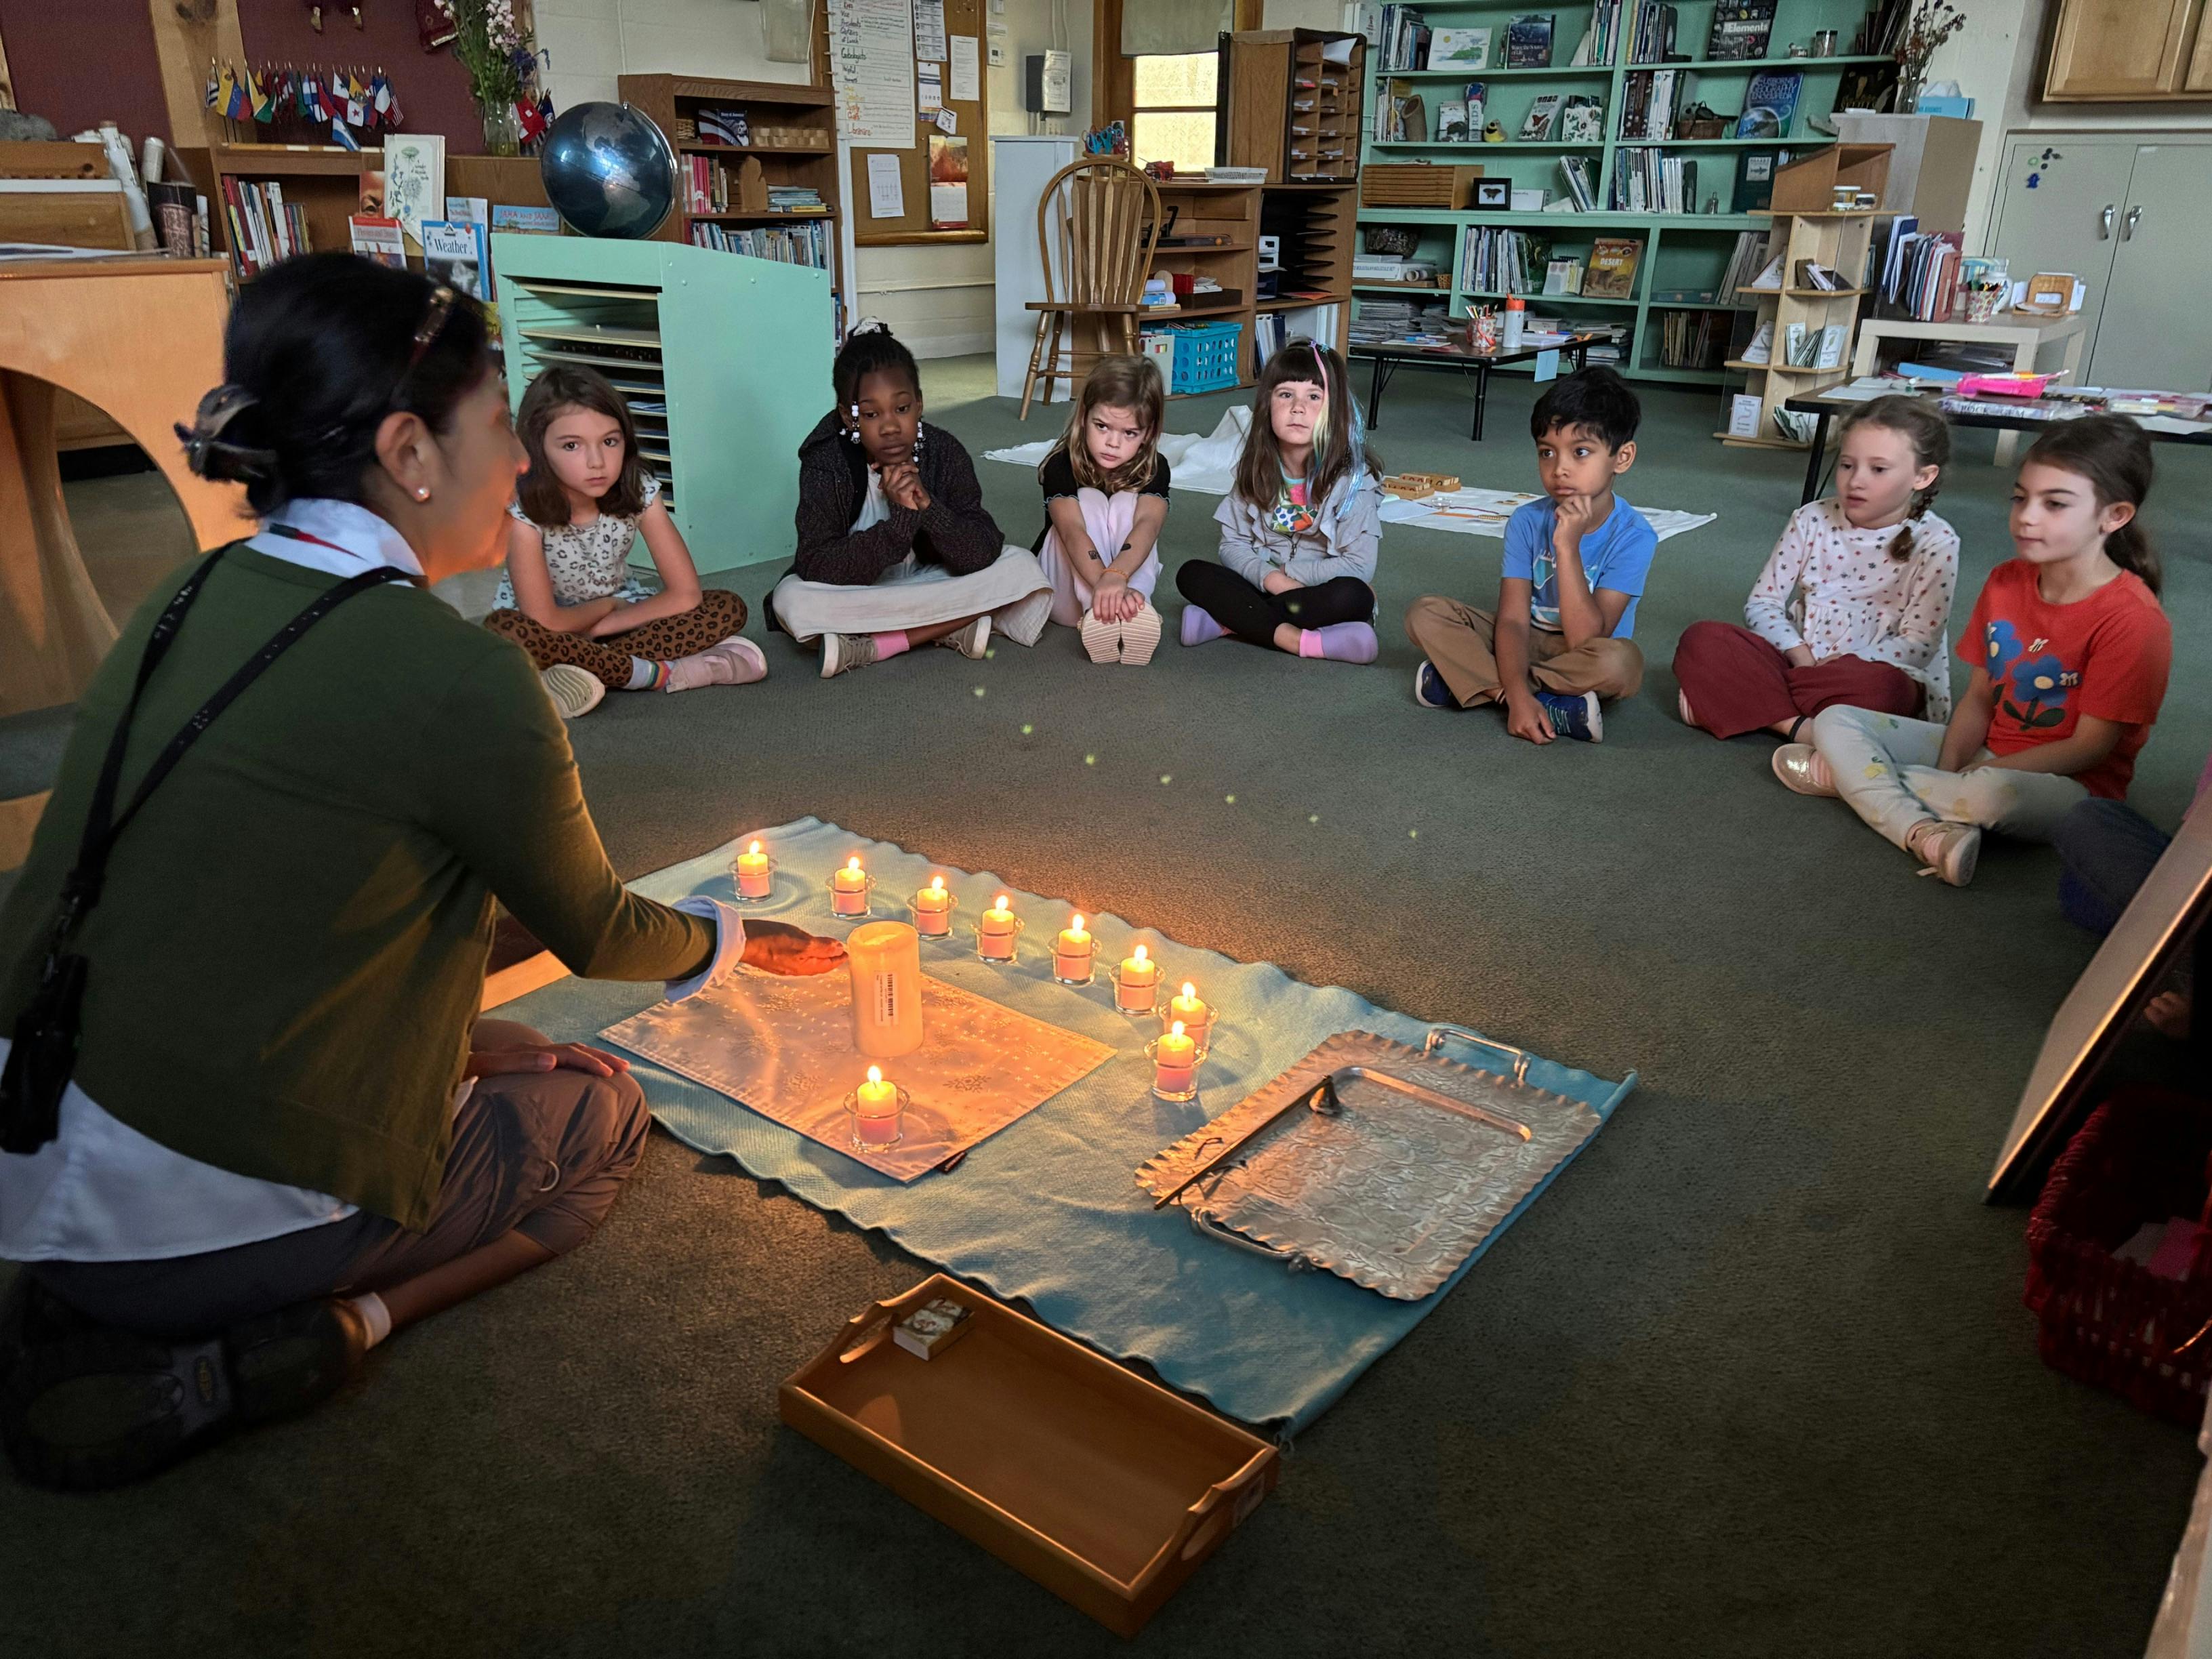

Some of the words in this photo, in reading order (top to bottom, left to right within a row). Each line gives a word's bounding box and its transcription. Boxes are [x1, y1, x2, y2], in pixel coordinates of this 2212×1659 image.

[1727, 21, 1768, 33] Elements
[1471, 104, 1479, 140] BIRDS
[434, 237, 468, 255] Weather
[1600, 258, 1624, 266] DESERT
